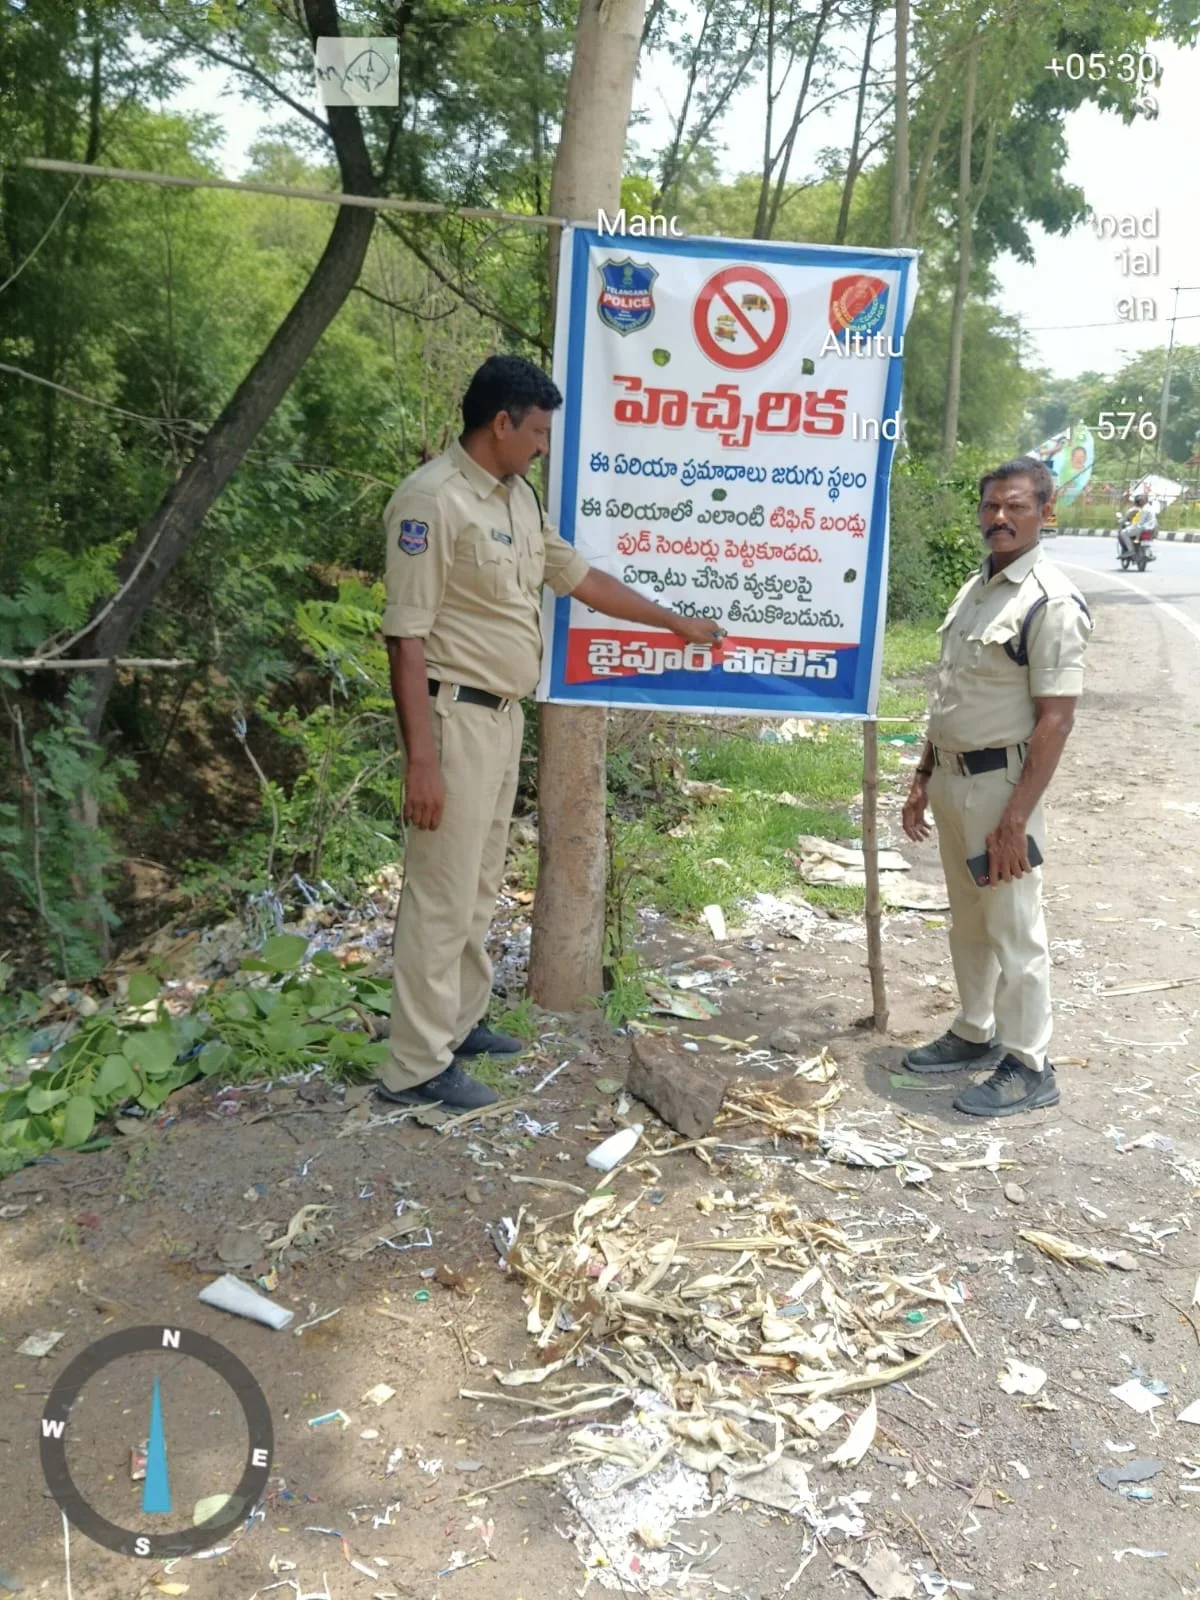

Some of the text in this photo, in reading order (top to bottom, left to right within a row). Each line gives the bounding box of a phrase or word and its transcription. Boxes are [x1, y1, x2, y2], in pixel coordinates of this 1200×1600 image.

[603, 293, 651, 308] POLICE
[606, 286, 648, 296] TELANGANA
[612, 375, 848, 448] హెచ్చరిక
[590, 452, 609, 472] ఈ
[614, 454, 677, 477] ఏరియా
[680, 458, 766, 486] ప్రమాదాలు
[772, 465, 823, 486] జరుగు
[581, 498, 866, 538] ఈ ఏరియాలో ఎలాంటి టిఫిన్ బండ్లు
[656, 536, 719, 562] సెంటర్లు
[724, 540, 822, 568] పెట్టకూడదు.
[623, 565, 812, 602] ఏర్పాటు చేసిన వ్యక్తులపై
[588, 638, 838, 679] జైపూర్ పోలీస్
